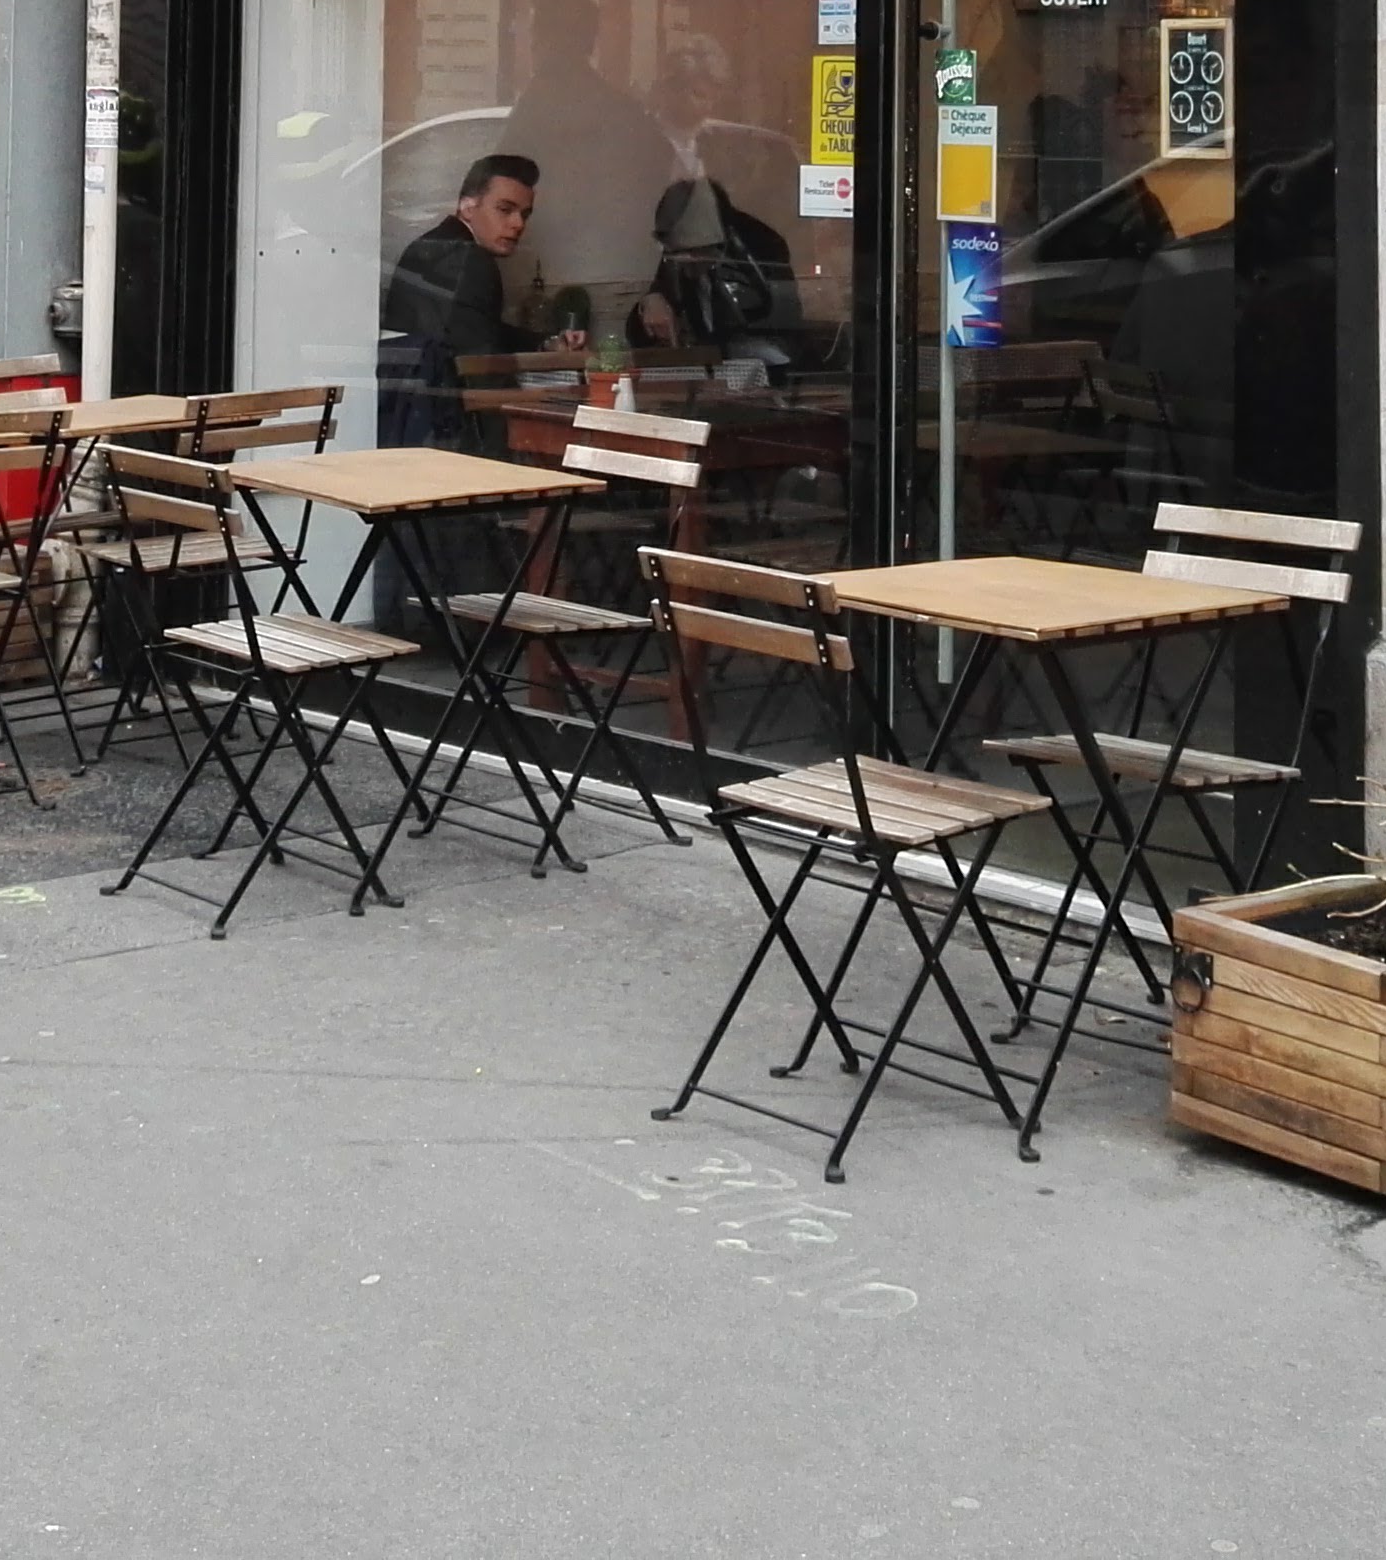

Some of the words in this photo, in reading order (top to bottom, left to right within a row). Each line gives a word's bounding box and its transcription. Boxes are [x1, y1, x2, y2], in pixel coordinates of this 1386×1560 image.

[951, 109, 986, 124] Chèque
[951, 122, 993, 137] Déjeuner
[951, 236, 1000, 252] sodexo
